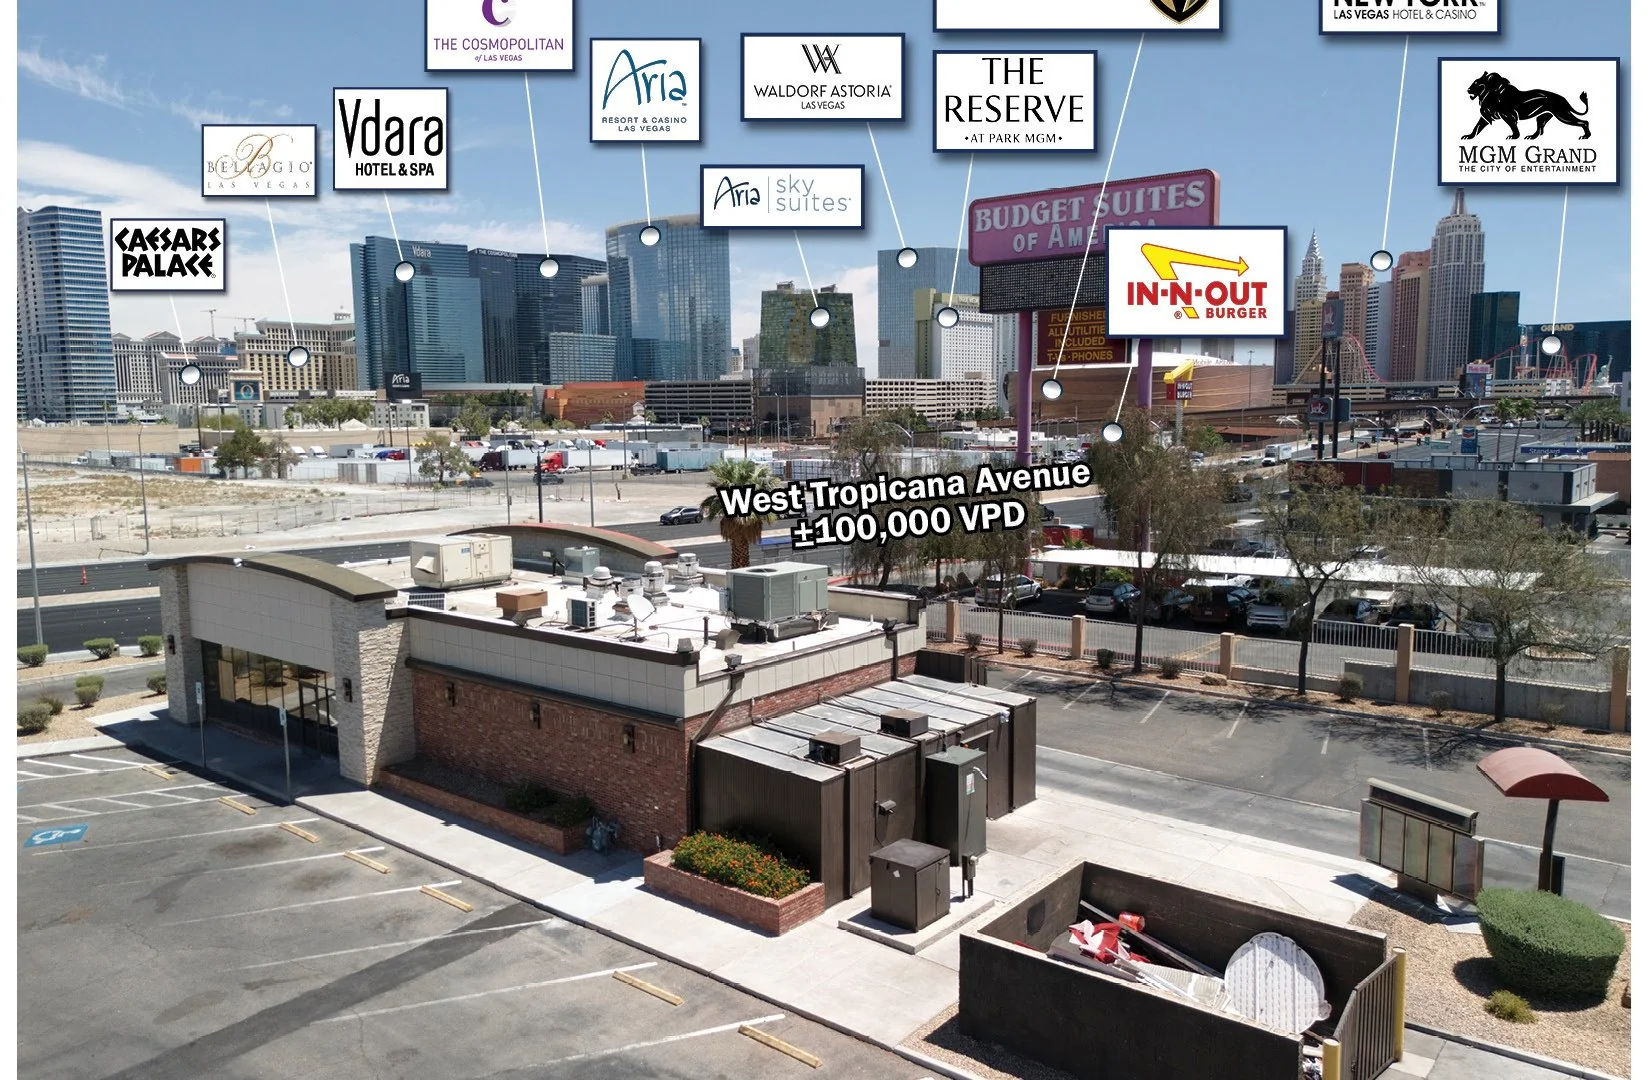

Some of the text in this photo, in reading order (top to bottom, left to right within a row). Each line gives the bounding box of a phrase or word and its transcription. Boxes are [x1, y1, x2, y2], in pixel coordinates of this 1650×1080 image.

[975, 180, 1205, 232] BUDGET SUITES
[1013, 232, 1039, 252] OF
[412, 245, 432, 258] Vdara
[1051, 311, 1106, 322] FURNISHE
[1048, 327, 1066, 337] ALL
[1540, 323, 1575, 332] GRAND
[1055, 336, 1106, 347] INCLUDED
[1071, 351, 1113, 361] PHONES
[392, 374, 410, 384] Aria
